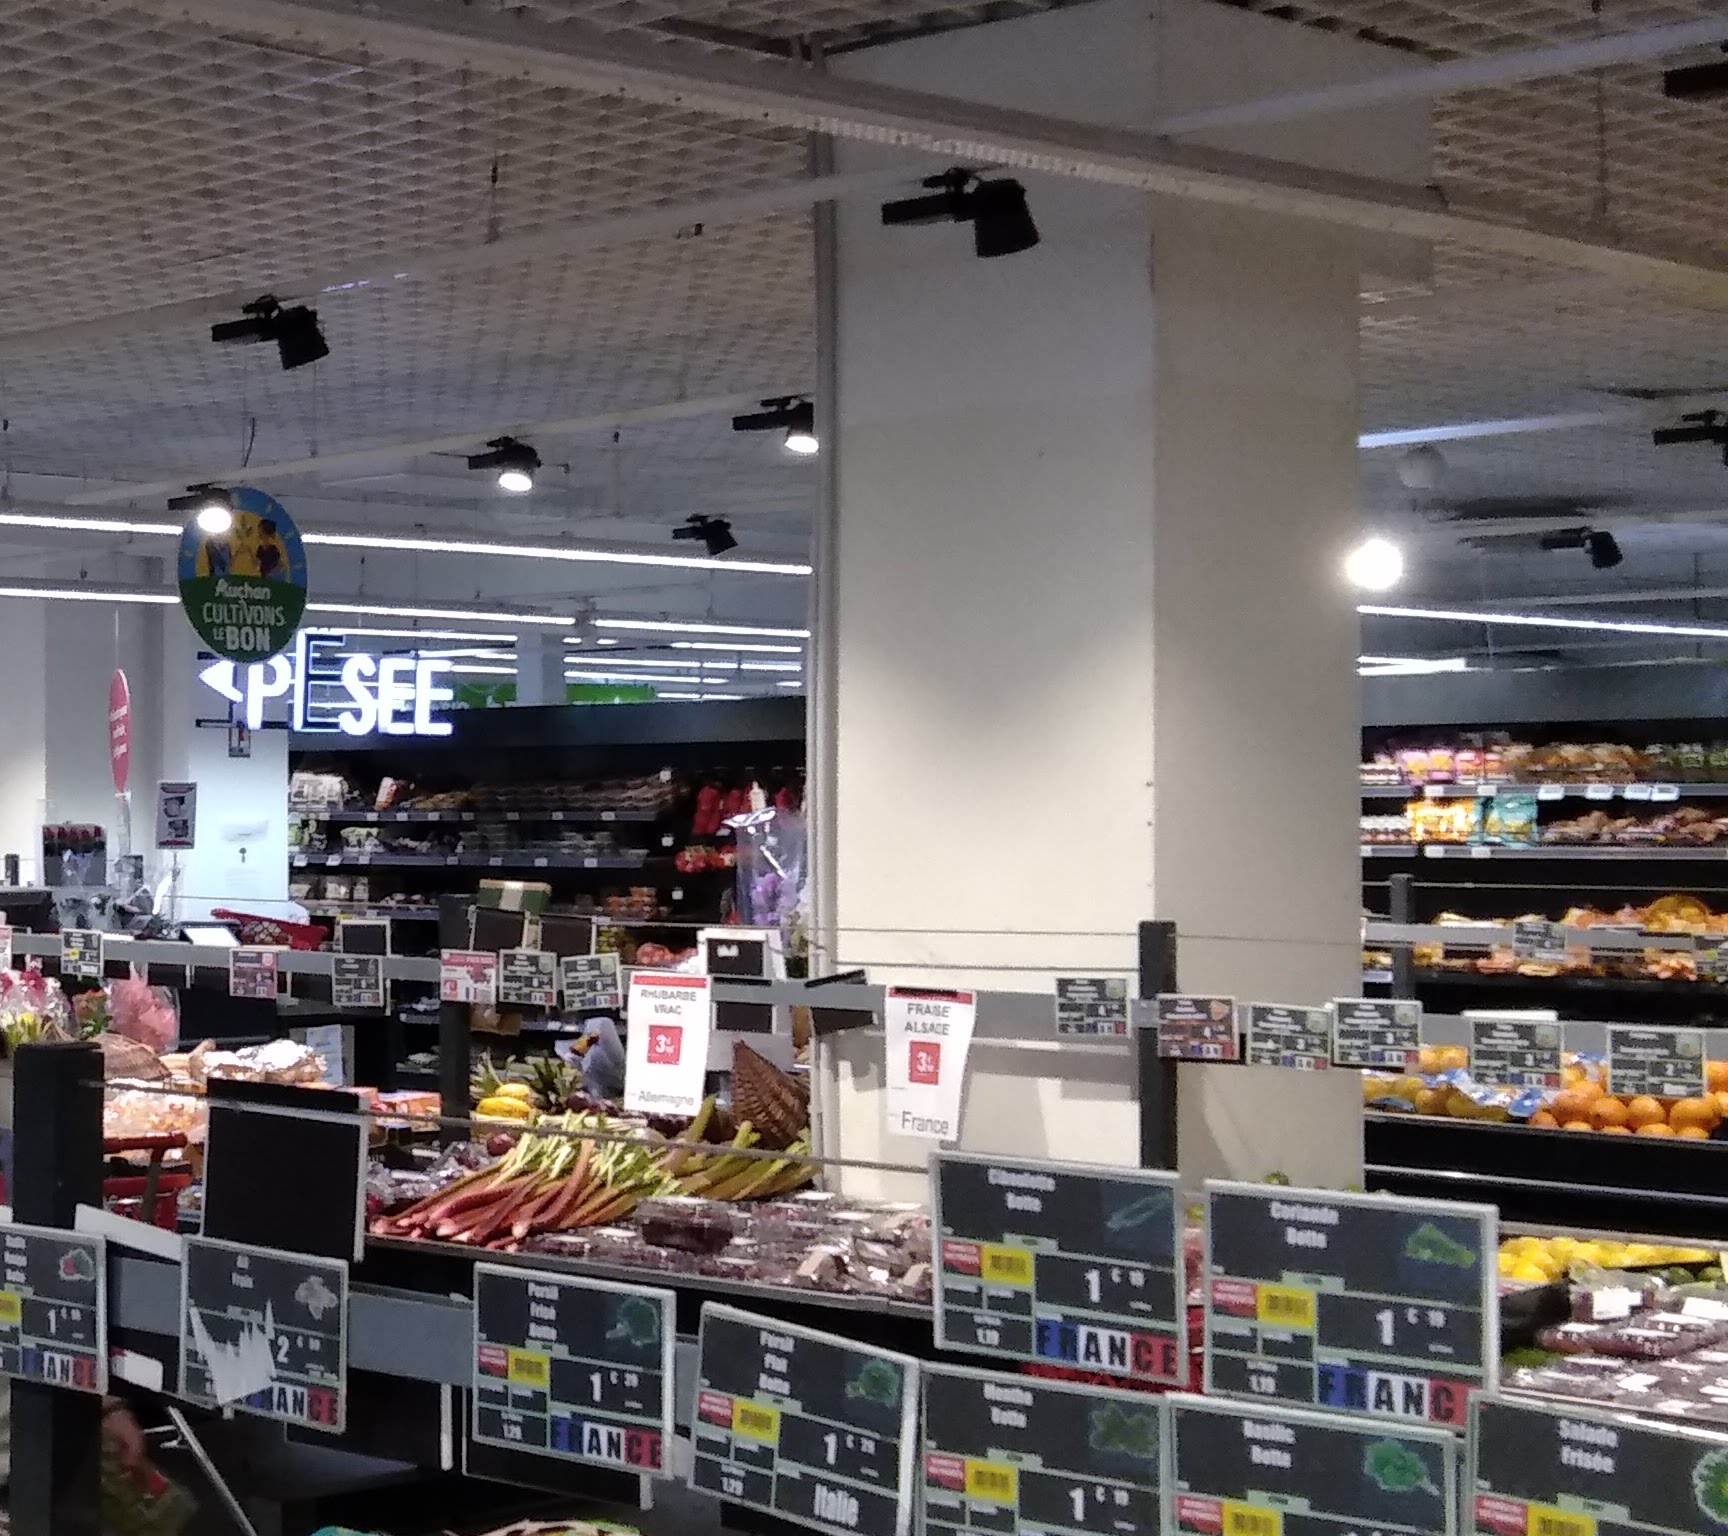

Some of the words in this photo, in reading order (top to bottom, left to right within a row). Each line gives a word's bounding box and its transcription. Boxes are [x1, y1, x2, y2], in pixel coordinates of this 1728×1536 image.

[215, 578, 271, 600] Auchan
[202, 601, 285, 627] CULTIVONS
[213, 627, 224, 641] LE
[225, 627, 270, 652] BON
[640, 989, 697, 1002] RHUBARBE
[654, 1004, 683, 1015] VRAC
[907, 1002, 950, 1019] FRAISE
[904, 1021, 950, 1037] ALSACE
[638, 1090, 694, 1108] Allemagne
[901, 1110, 950, 1136] France
[276, 1335, 291, 1364] 2
[1038, 1319, 1178, 1378] FRANCE
[1320, 1366, 1455, 1424] FRANC
[1560, 1446, 1616, 1475] Frisée
[813, 1482, 860, 1528] Italie
